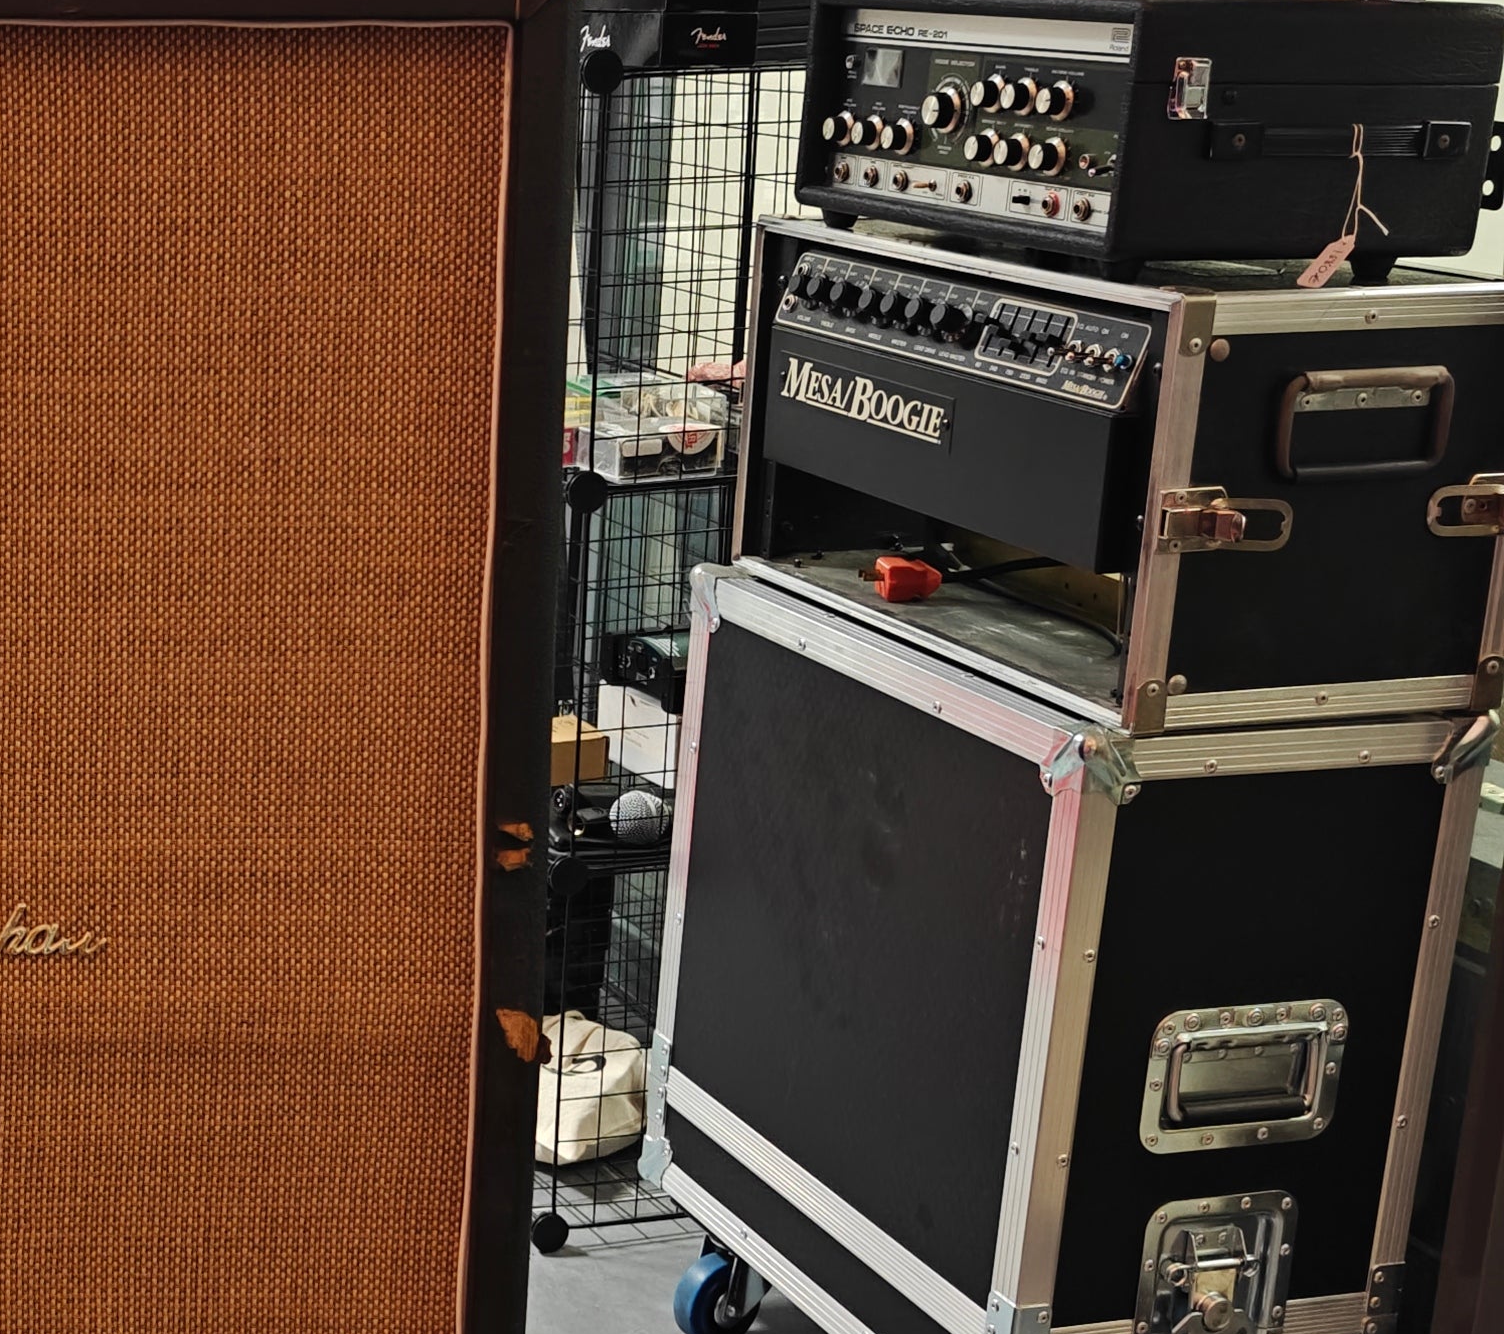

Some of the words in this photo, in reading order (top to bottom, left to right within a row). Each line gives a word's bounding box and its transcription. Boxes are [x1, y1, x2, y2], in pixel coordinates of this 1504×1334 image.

[580, 25, 611, 52] Fender
[690, 26, 727, 45] Fender
[854, 23, 884, 34] SPACE
[886, 25, 915, 37] ECHO
[917, 29, 948, 39] RE-201
[1109, 43, 1130, 52] Roland
[781, 357, 945, 440] MESA/BOOGIE
